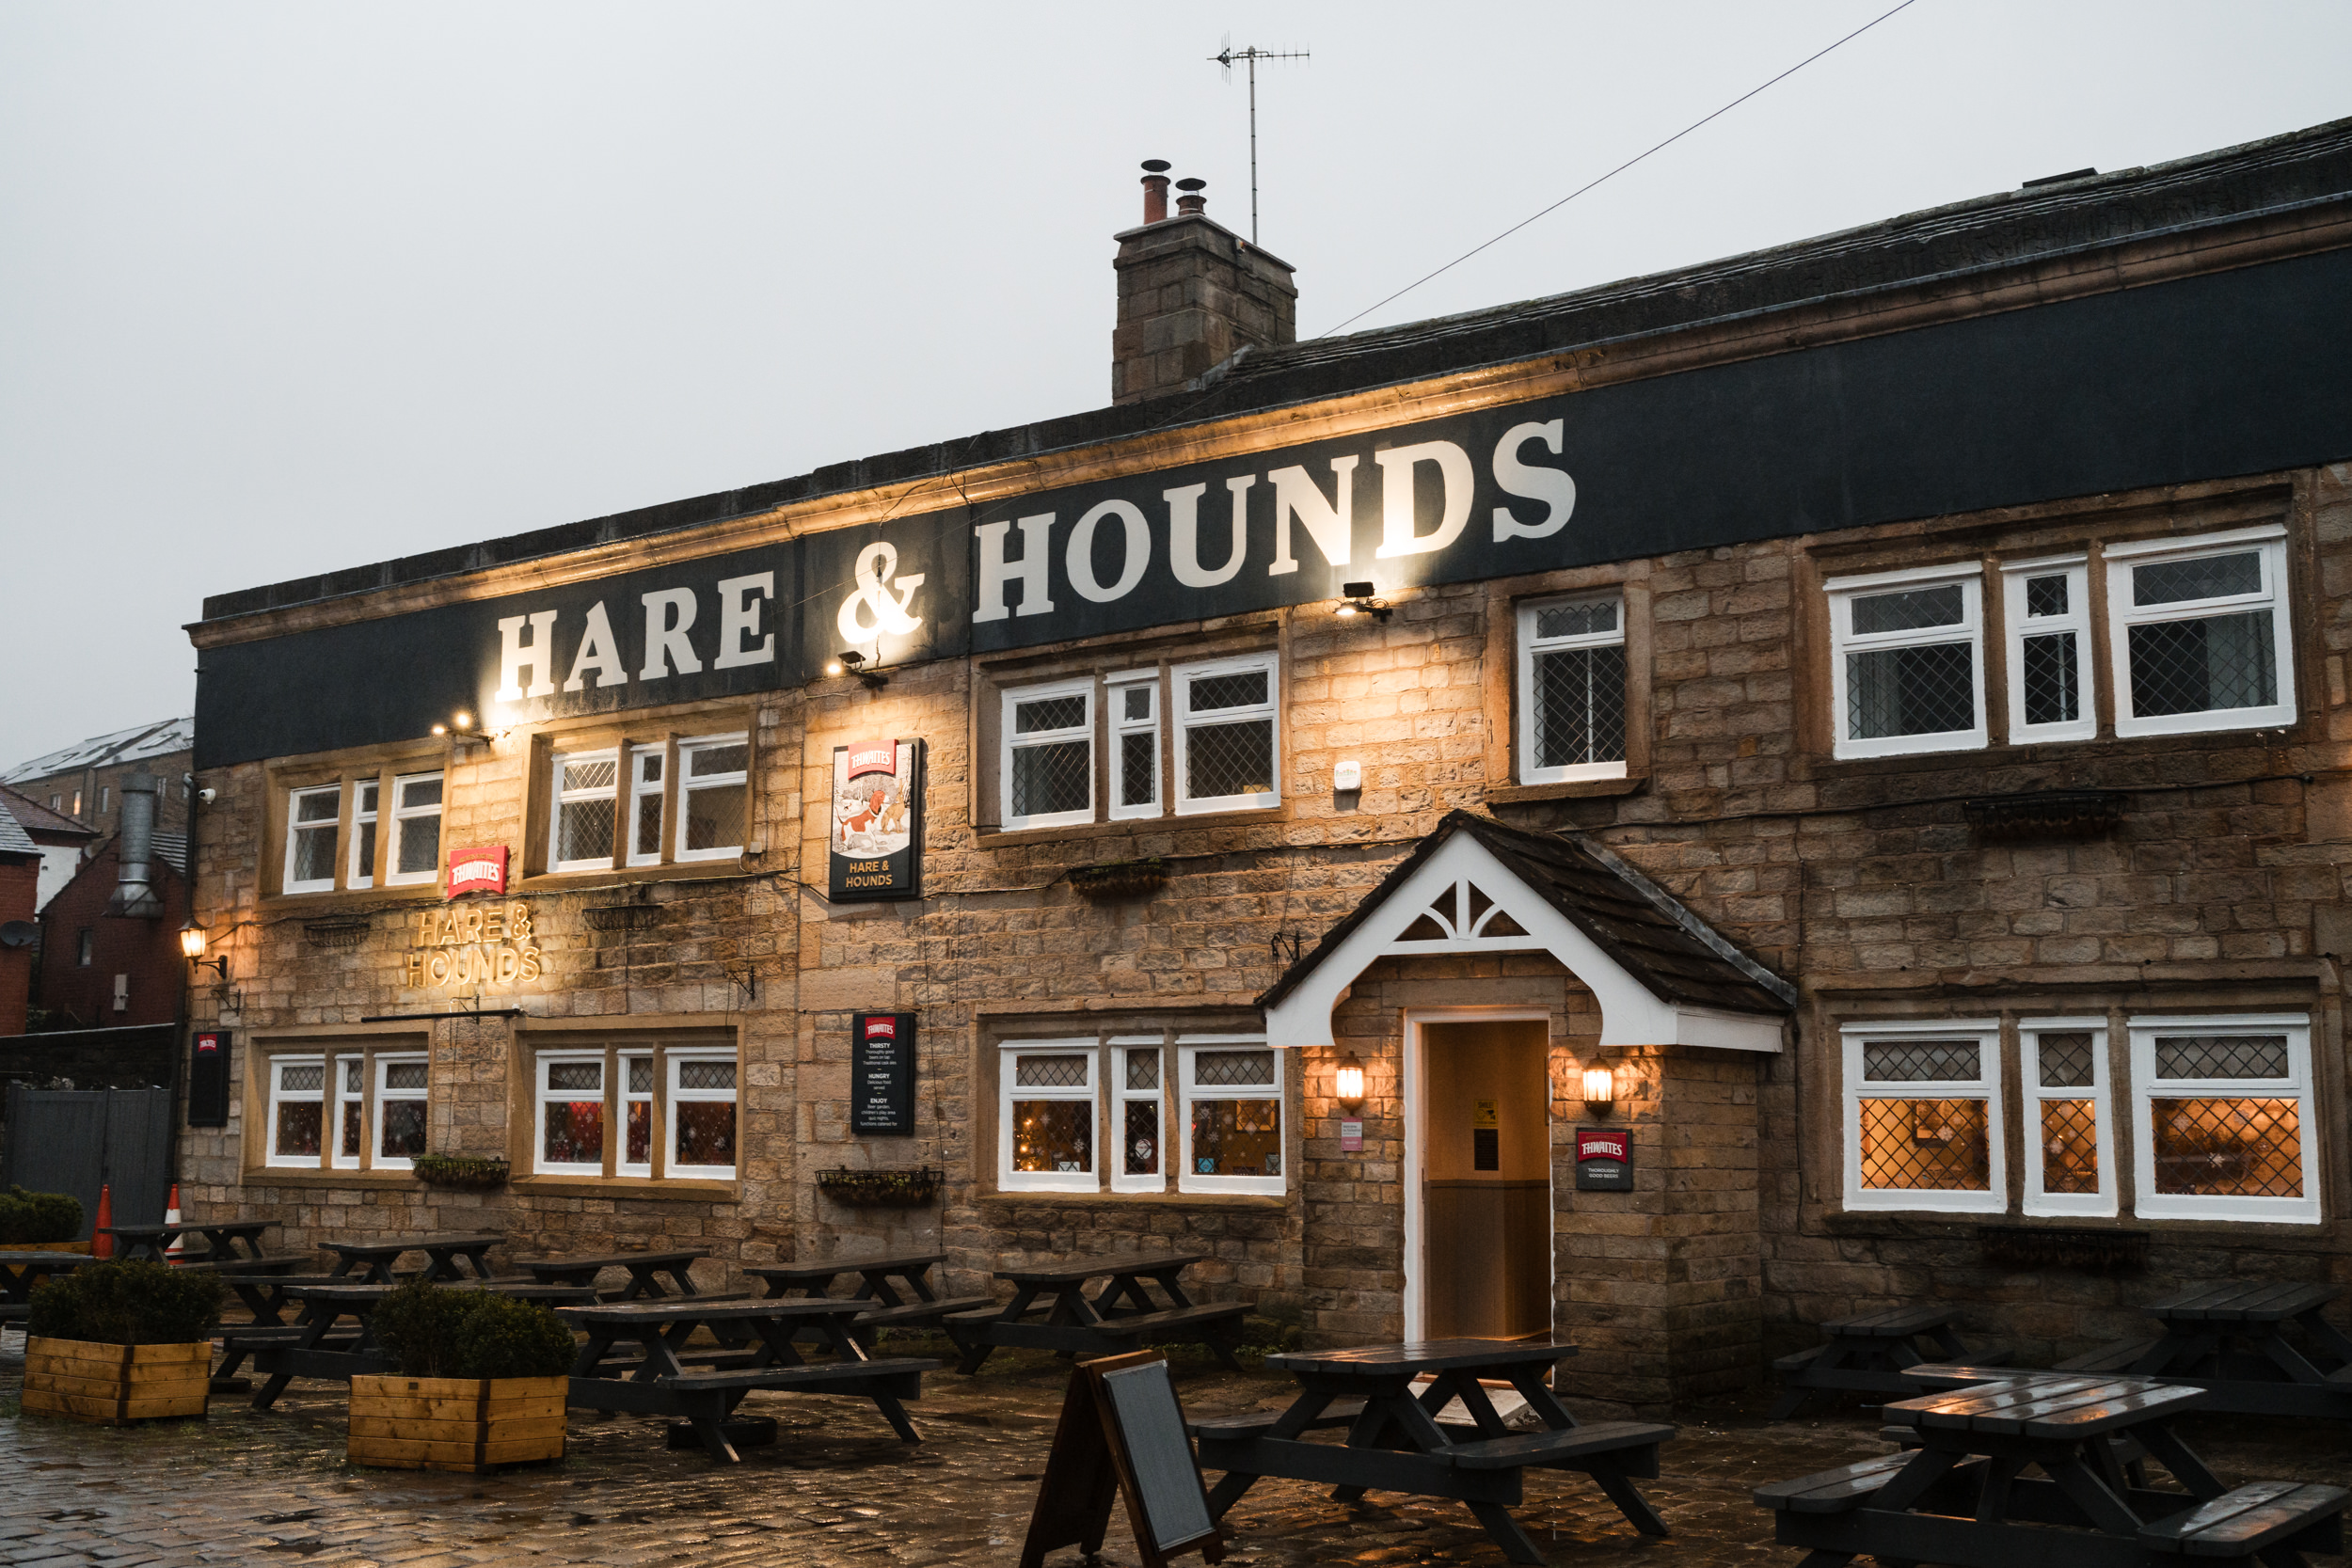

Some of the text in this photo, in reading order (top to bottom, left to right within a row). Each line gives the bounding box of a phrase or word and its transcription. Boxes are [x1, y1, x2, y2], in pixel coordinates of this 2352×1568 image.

[494, 418, 1576, 704] HARE & HOUNDS
[850, 750, 891, 769] THWAITES
[452, 861, 500, 886] THWAITES
[849, 860, 889, 873] HARE &
[845, 874, 893, 888] HOUNDS
[417, 904, 533, 947] HARE &
[406, 946, 541, 988] HOUNDS
[867, 1023, 894, 1035] THWAITES
[1581, 1141, 1623, 1156] THWAITES
